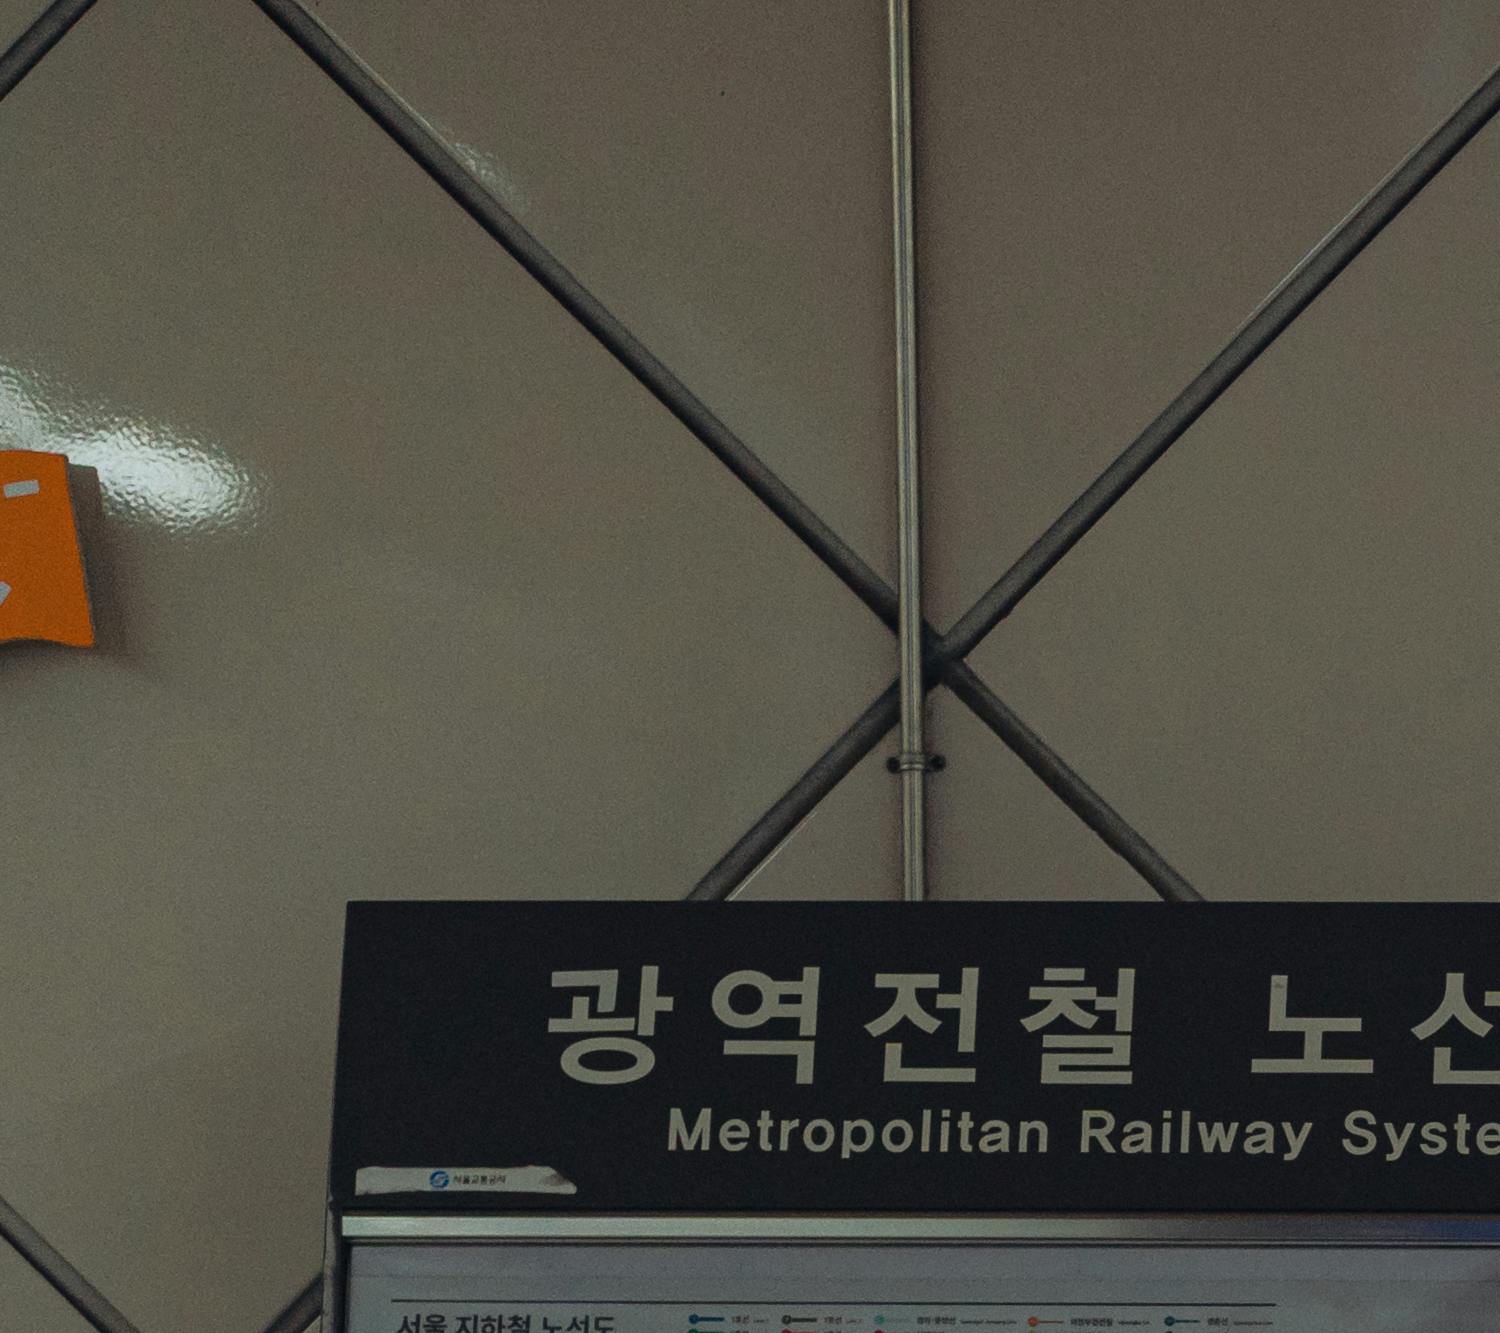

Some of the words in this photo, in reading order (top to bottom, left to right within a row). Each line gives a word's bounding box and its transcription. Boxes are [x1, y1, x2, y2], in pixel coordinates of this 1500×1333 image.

[546, 964, 1137, 1087] 광역전철
[667, 1107, 1049, 1160] Metropolitan
[1079, 1109, 1314, 1162] Railway
